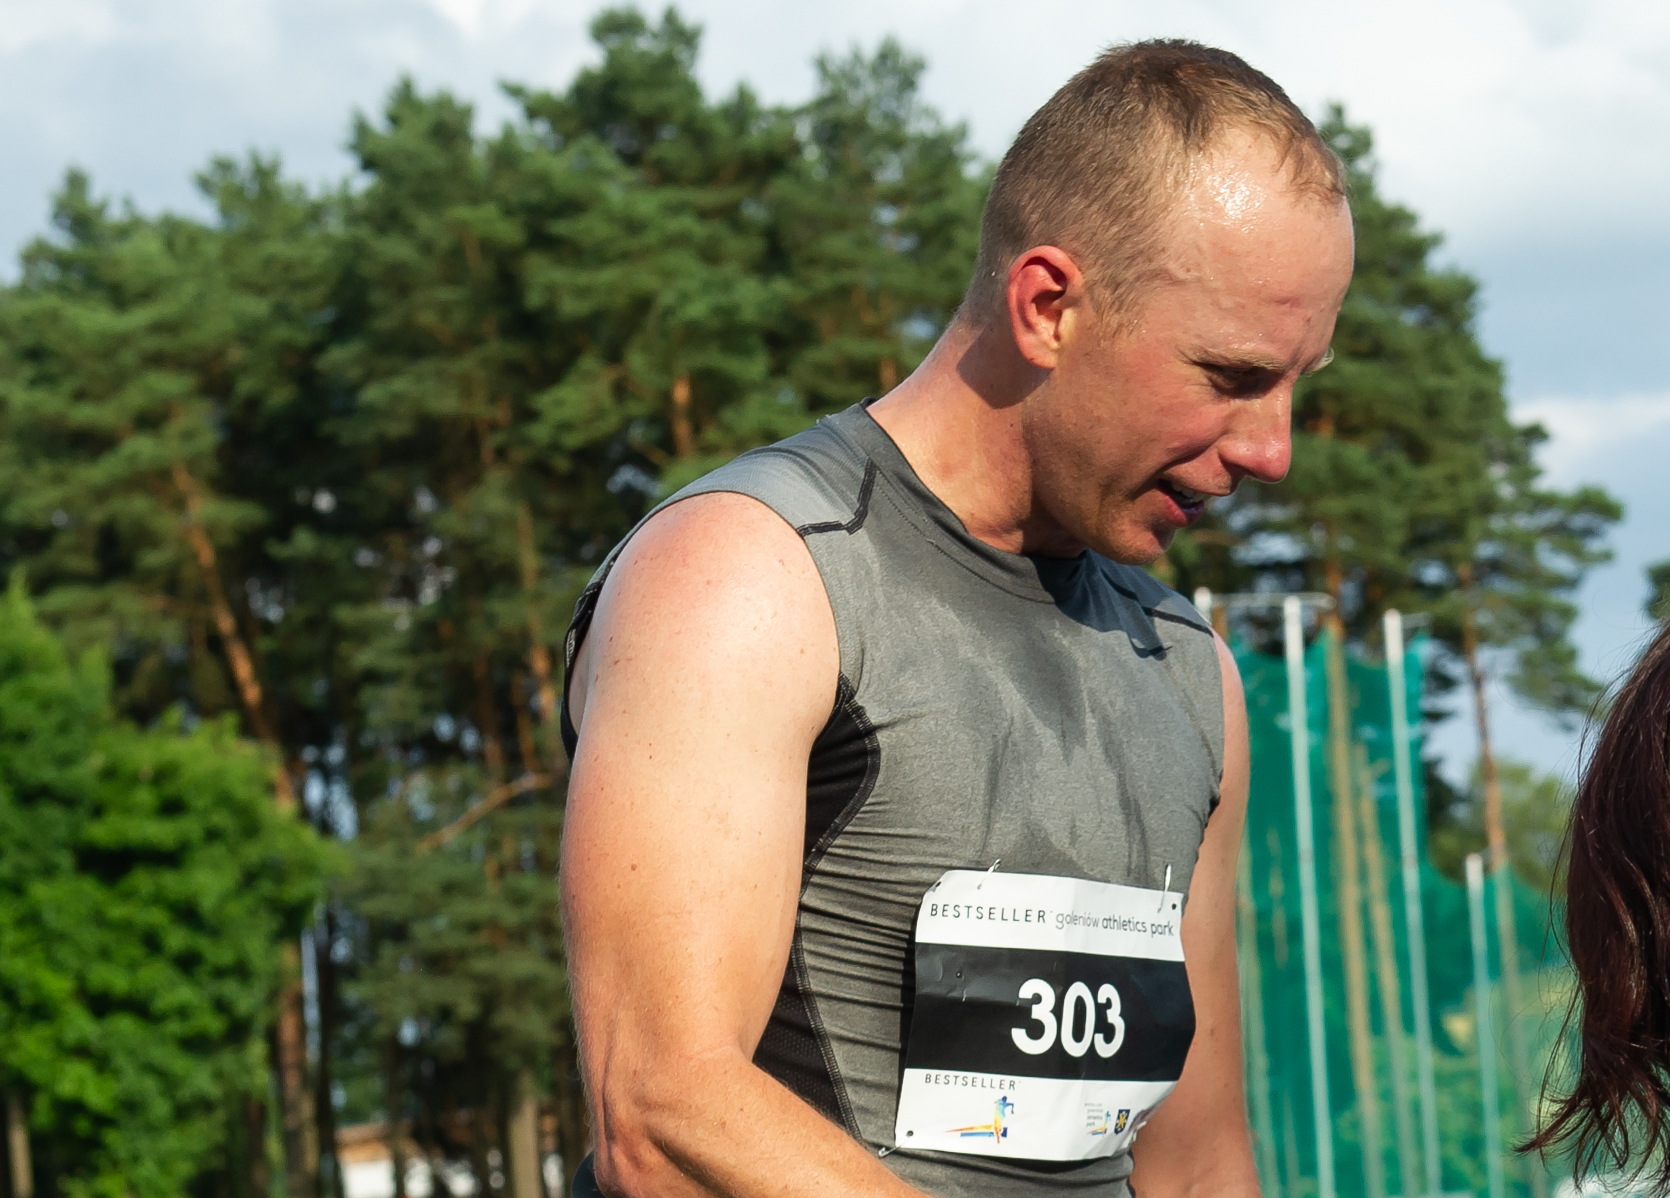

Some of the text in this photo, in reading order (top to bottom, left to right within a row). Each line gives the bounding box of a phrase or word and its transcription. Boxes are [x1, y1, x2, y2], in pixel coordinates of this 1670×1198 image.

[930, 903, 1174, 938] BESTSELLER goleniów athletics park
[1011, 978, 1125, 1058] 303
[924, 1073, 1016, 1091] BESTSELLER
